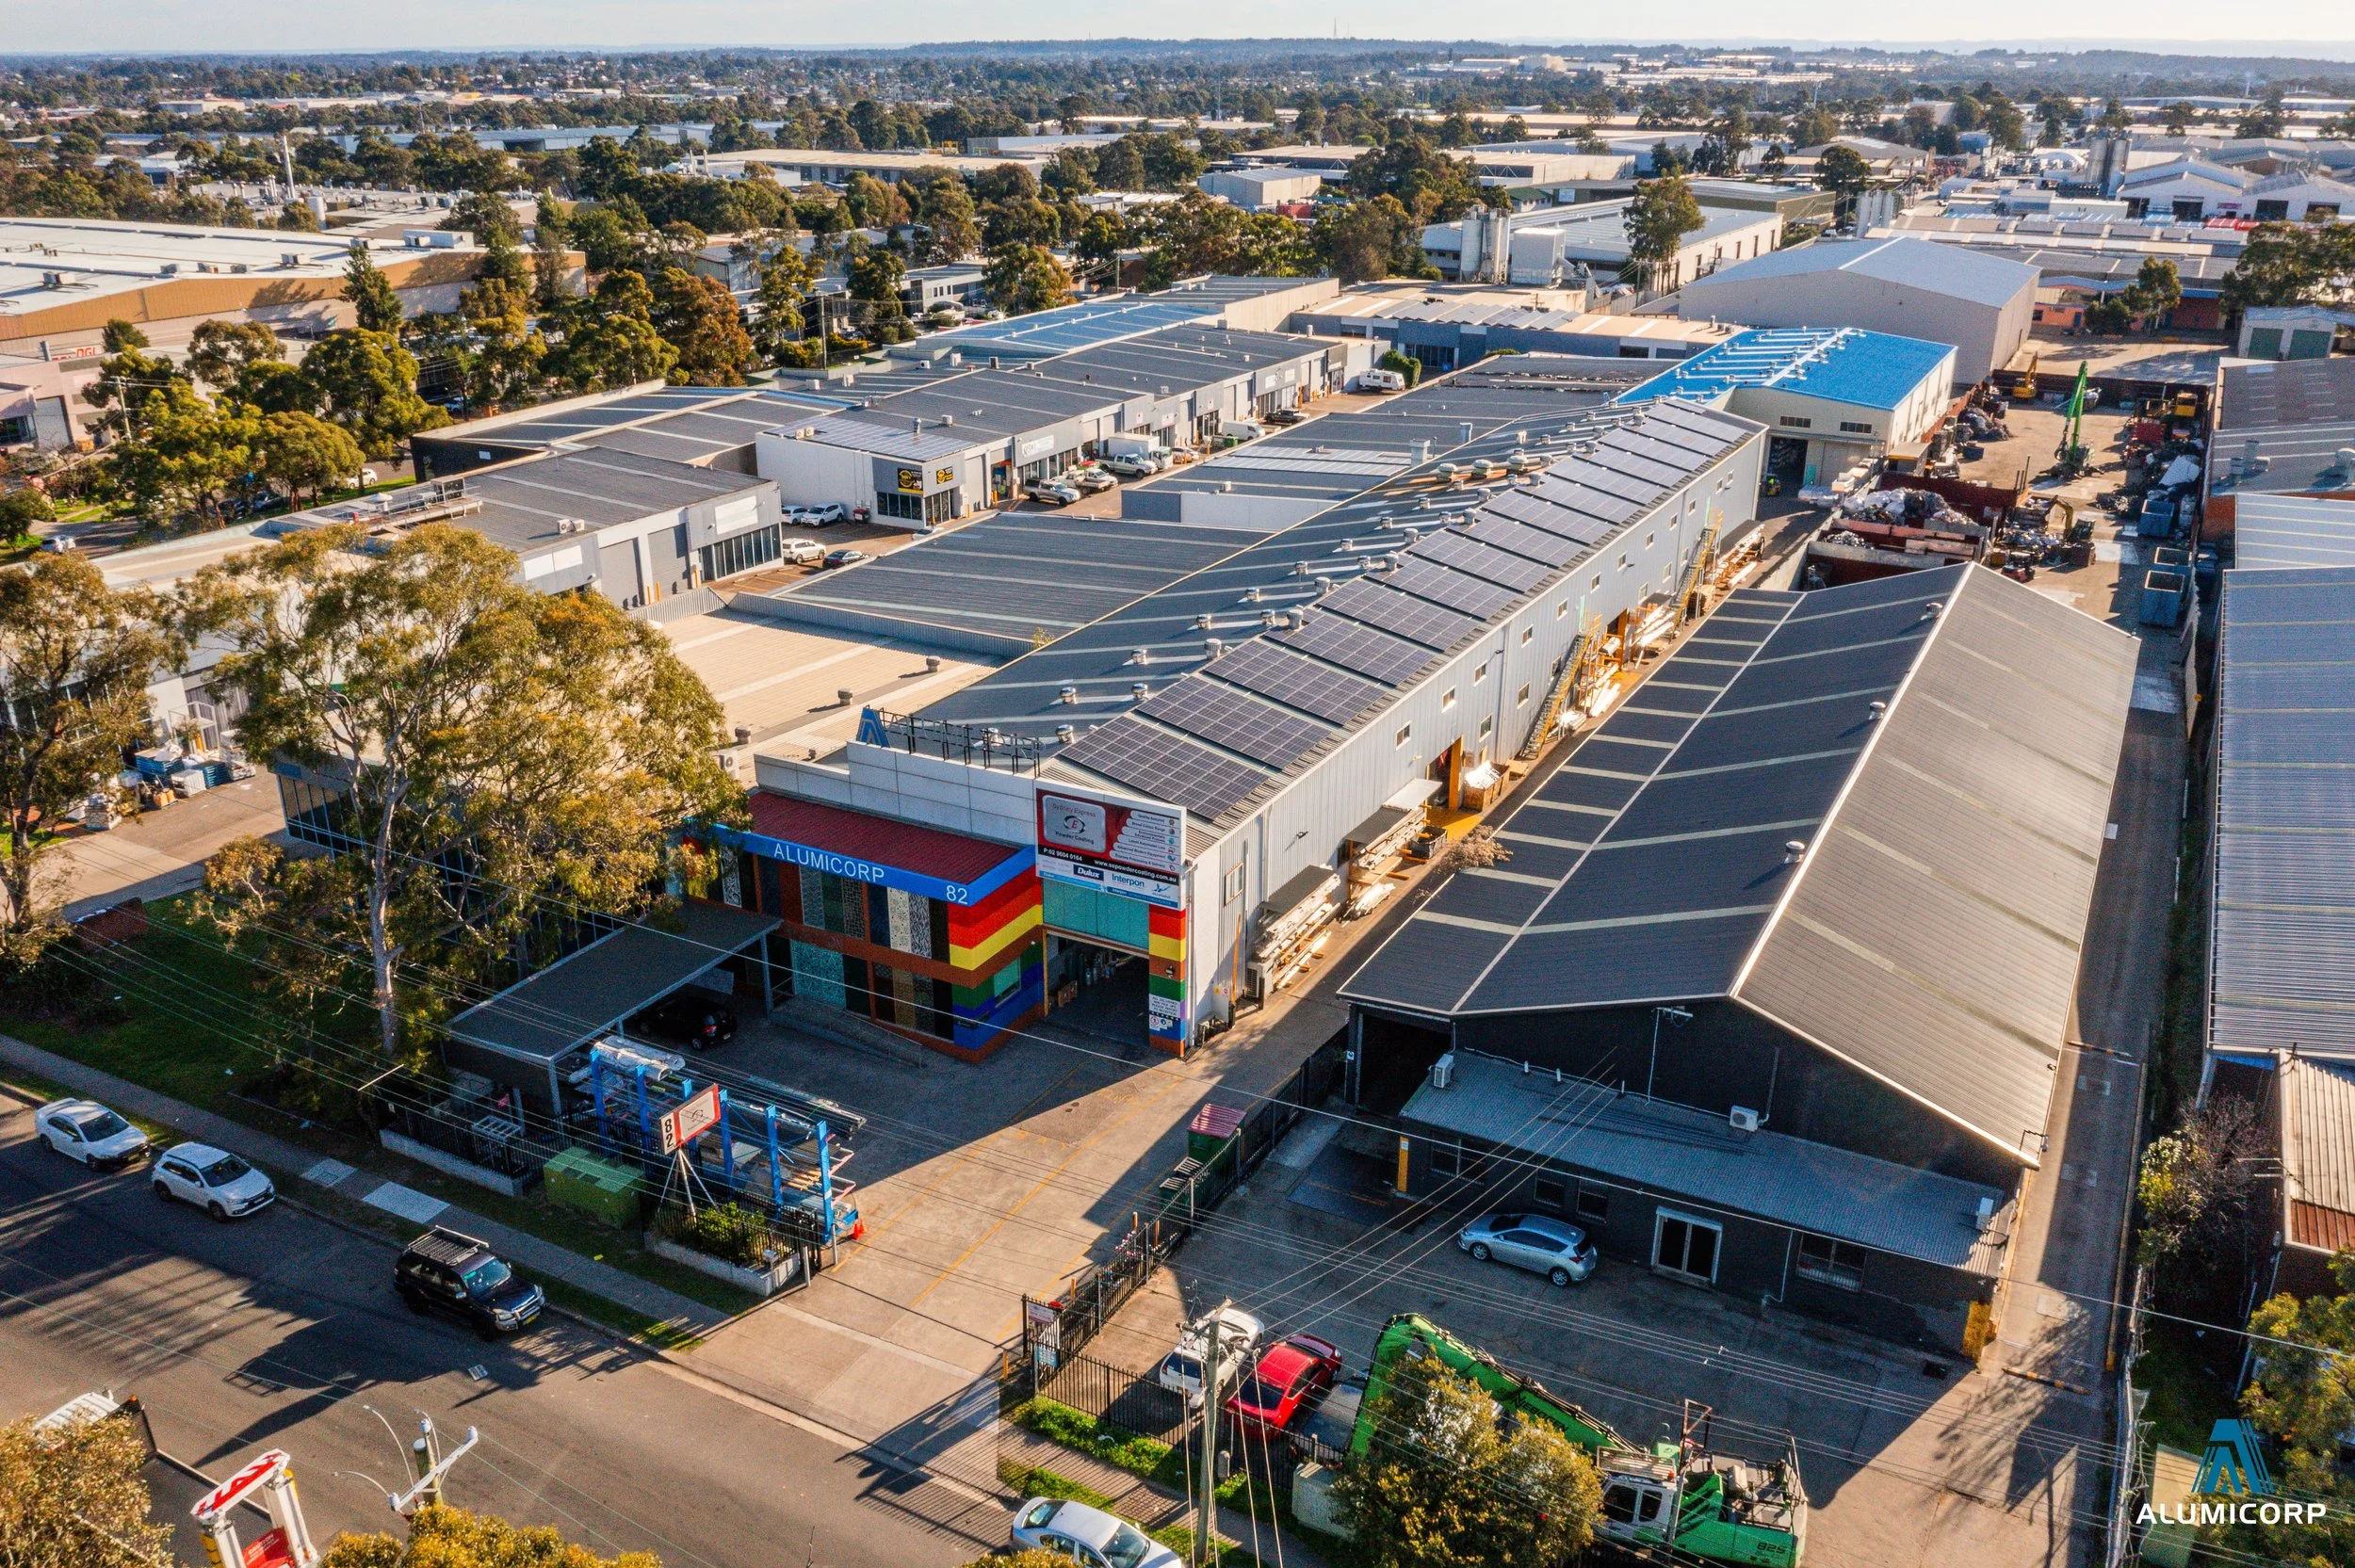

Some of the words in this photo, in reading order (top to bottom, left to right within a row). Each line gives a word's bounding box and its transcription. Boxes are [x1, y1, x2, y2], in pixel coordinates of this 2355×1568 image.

[1052, 802, 1073, 814] Sydney
[1074, 807, 1096, 817] Express
[1056, 831, 1073, 839] Powder
[1075, 835, 1094, 845] Coating
[1056, 850, 1068, 859] 9604
[773, 843, 885, 882] ALUMICORP
[1078, 867, 1100, 879] Dulux
[1112, 873, 1145, 888] Interpon
[946, 884, 968, 905] 82
[664, 1118, 674, 1148] 82
[1757, 1542, 1787, 1554] 825
